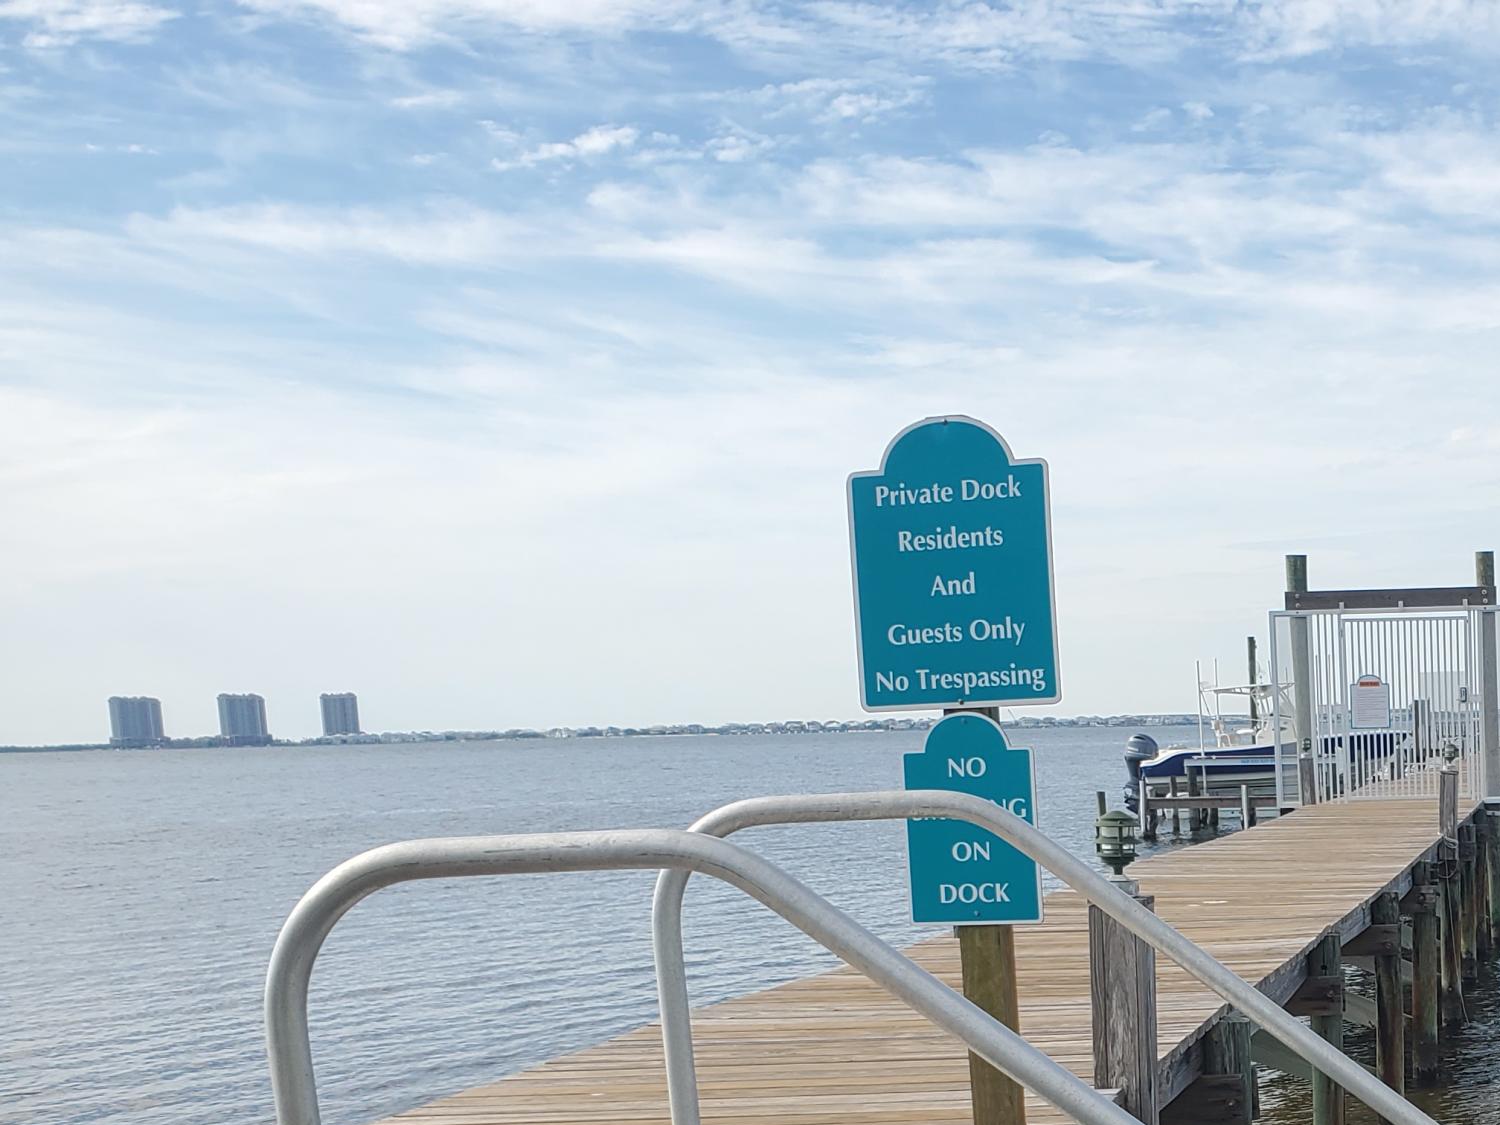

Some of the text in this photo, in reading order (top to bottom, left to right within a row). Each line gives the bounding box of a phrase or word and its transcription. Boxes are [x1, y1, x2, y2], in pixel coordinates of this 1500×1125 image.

[875, 474, 1022, 507] Private Dock
[898, 526, 1004, 552] Residents
[930, 572, 976, 597] And
[887, 616, 1025, 646] Guests Only
[875, 663, 1046, 695] No Trespassing
[947, 756, 987, 778] NO
[951, 841, 991, 862] ON
[939, 882, 1011, 904] DOCK
